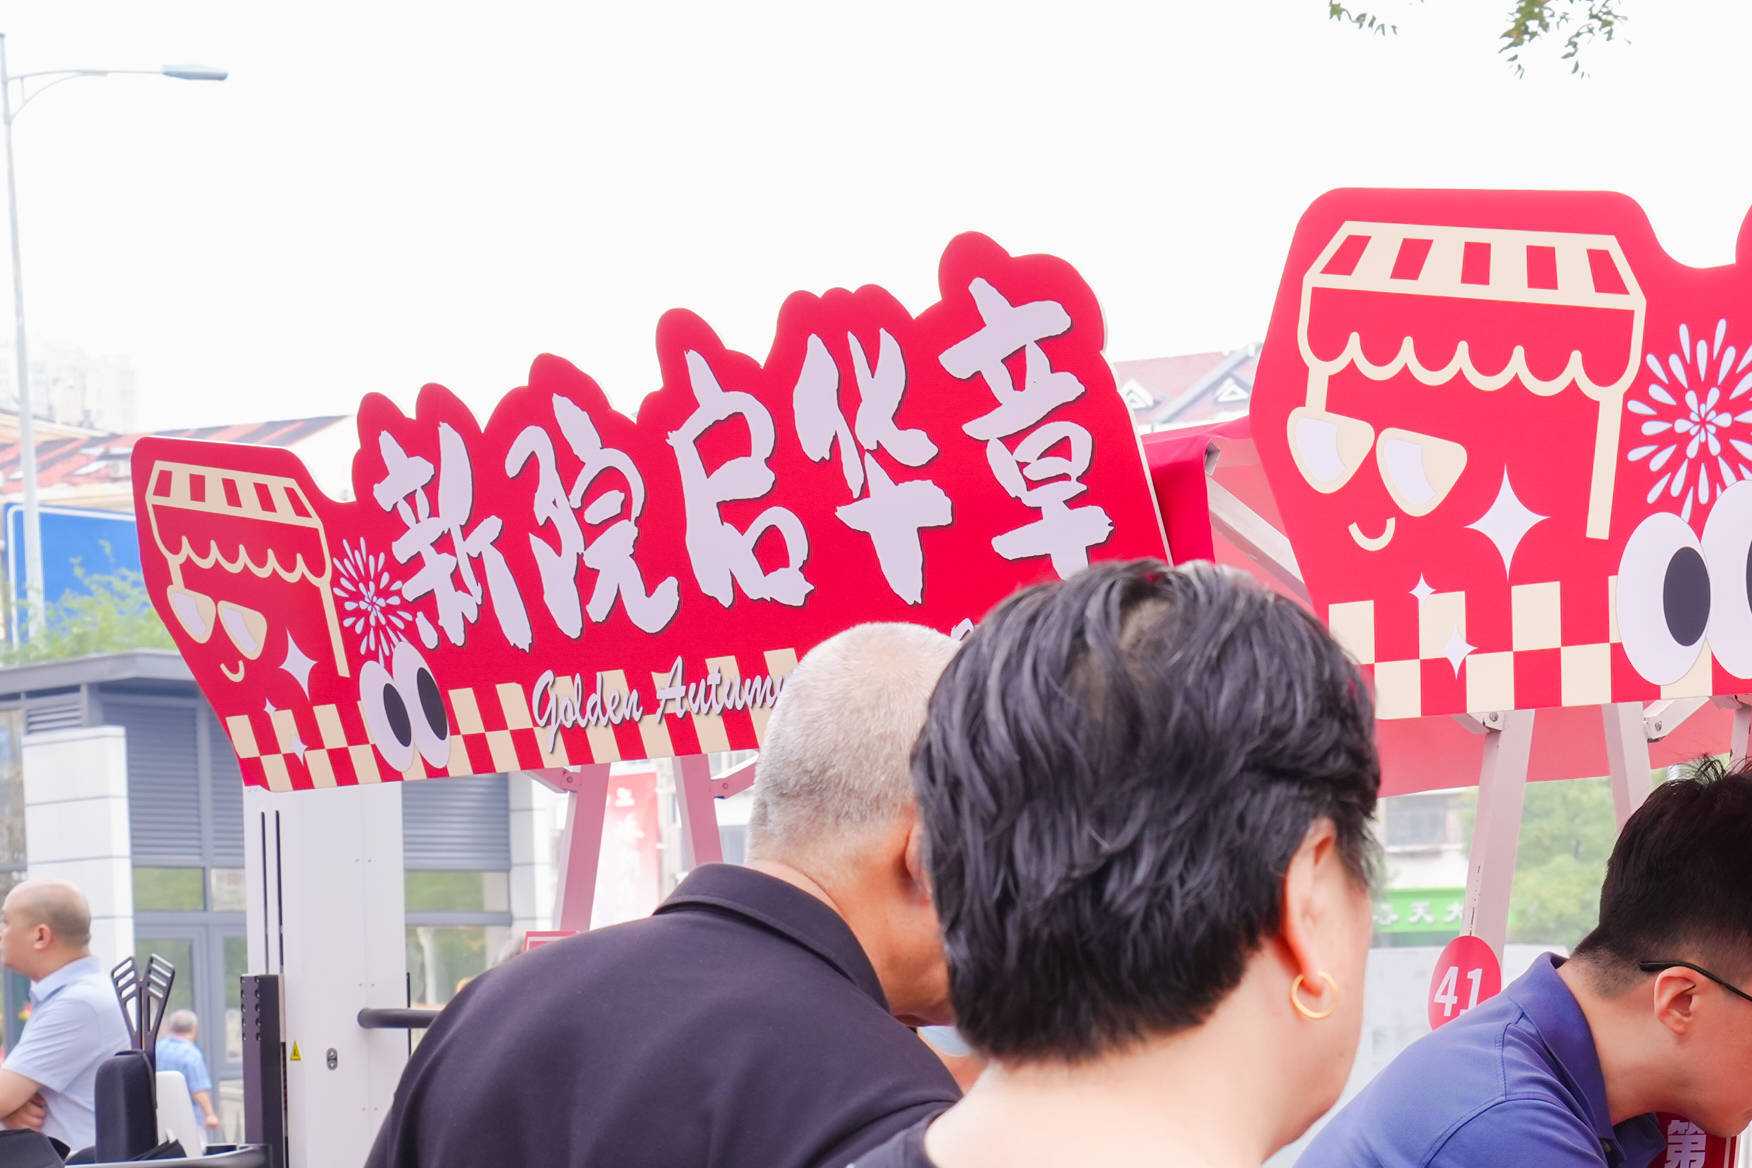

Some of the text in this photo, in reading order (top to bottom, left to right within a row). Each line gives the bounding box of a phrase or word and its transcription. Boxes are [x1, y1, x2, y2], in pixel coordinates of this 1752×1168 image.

[373, 276, 1114, 652] 新院启华章
[532, 655, 787, 753] Golden Autum
[1433, 966, 1482, 1017] 41
